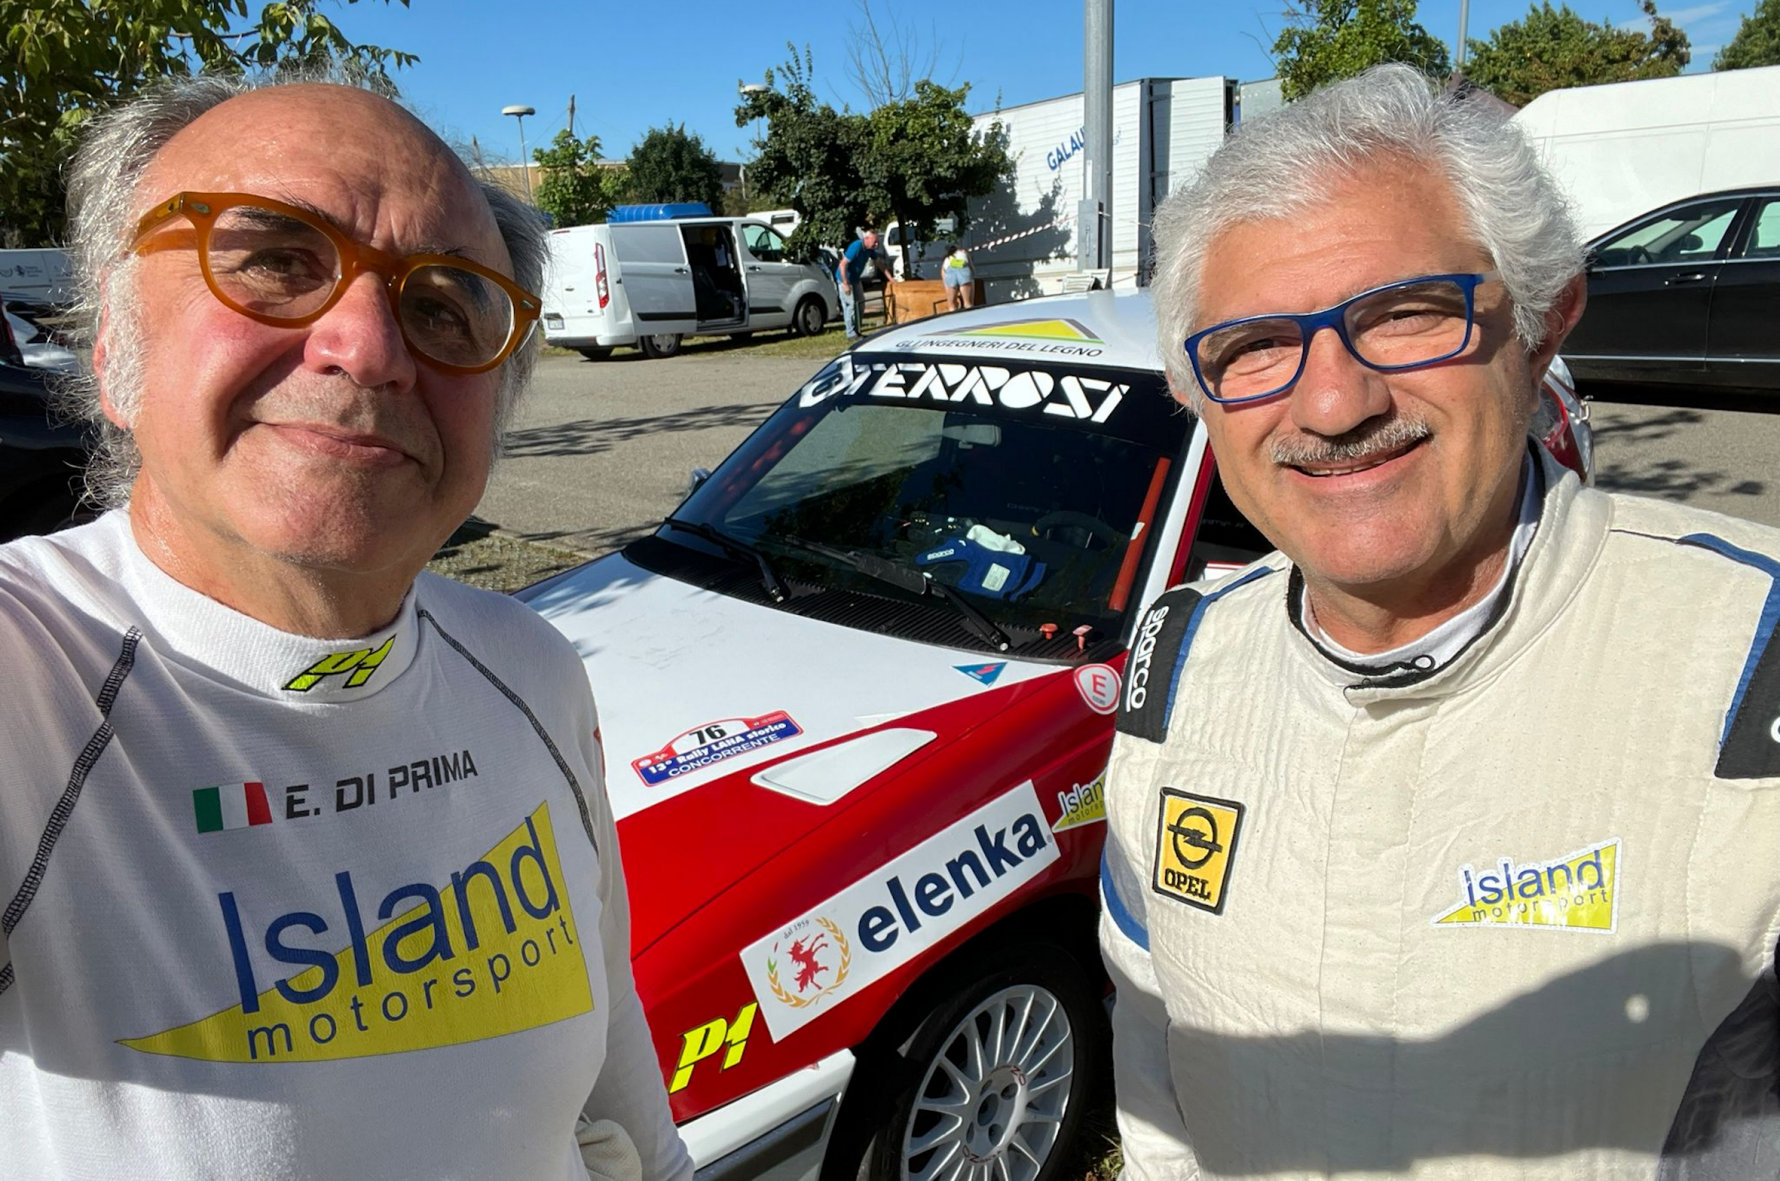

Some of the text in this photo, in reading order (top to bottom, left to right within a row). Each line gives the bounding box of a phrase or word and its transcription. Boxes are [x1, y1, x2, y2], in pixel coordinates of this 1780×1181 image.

[920, 340, 1004, 349] INGEGNERI
[1005, 342, 1037, 351] DEL
[1039, 344, 1103, 357] LEGNO
[845, 363, 1130, 423] TERROSI
[1092, 674, 1107, 698] E
[1129, 605, 1170, 710] sparco
[668, 733, 780, 776] CONCORRENTE
[676, 747, 709, 764] Rally
[711, 735, 745, 751] LANA
[747, 723, 786, 739] storico
[689, 725, 727, 745] 76
[286, 750, 478, 819] E. DI PRIMA
[858, 813, 1047, 953] elenka
[1164, 868, 1211, 900] OPEL
[1464, 850, 1605, 907] Island
[218, 816, 561, 1015] Island
[247, 914, 573, 1060] motorsport
[668, 1001, 758, 1094] P1
